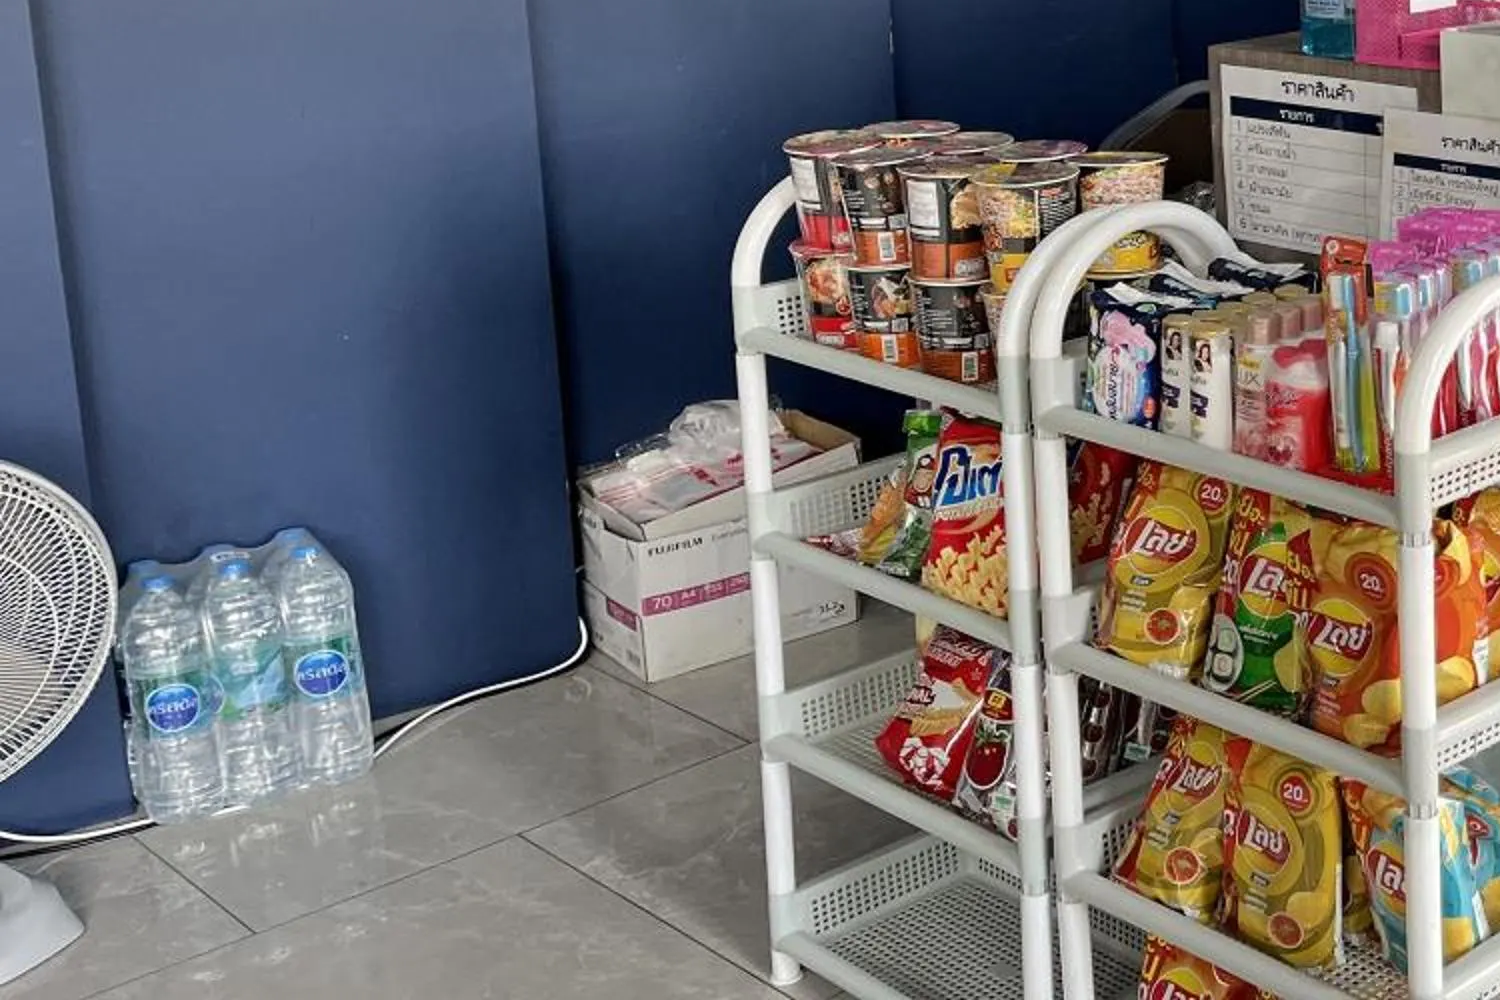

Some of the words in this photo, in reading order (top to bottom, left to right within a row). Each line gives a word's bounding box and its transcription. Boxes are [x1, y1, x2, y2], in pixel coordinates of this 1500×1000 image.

[1281, 81, 1355, 102] ราคาสินค้า
[934, 446, 1003, 506] โปเต
[647, 537, 703, 557] FUJIFILM
[1132, 519, 1191, 556] เลย์
[1242, 558, 1285, 598] เล
[653, 596, 673, 610] 70
[1375, 854, 1405, 895] เล
